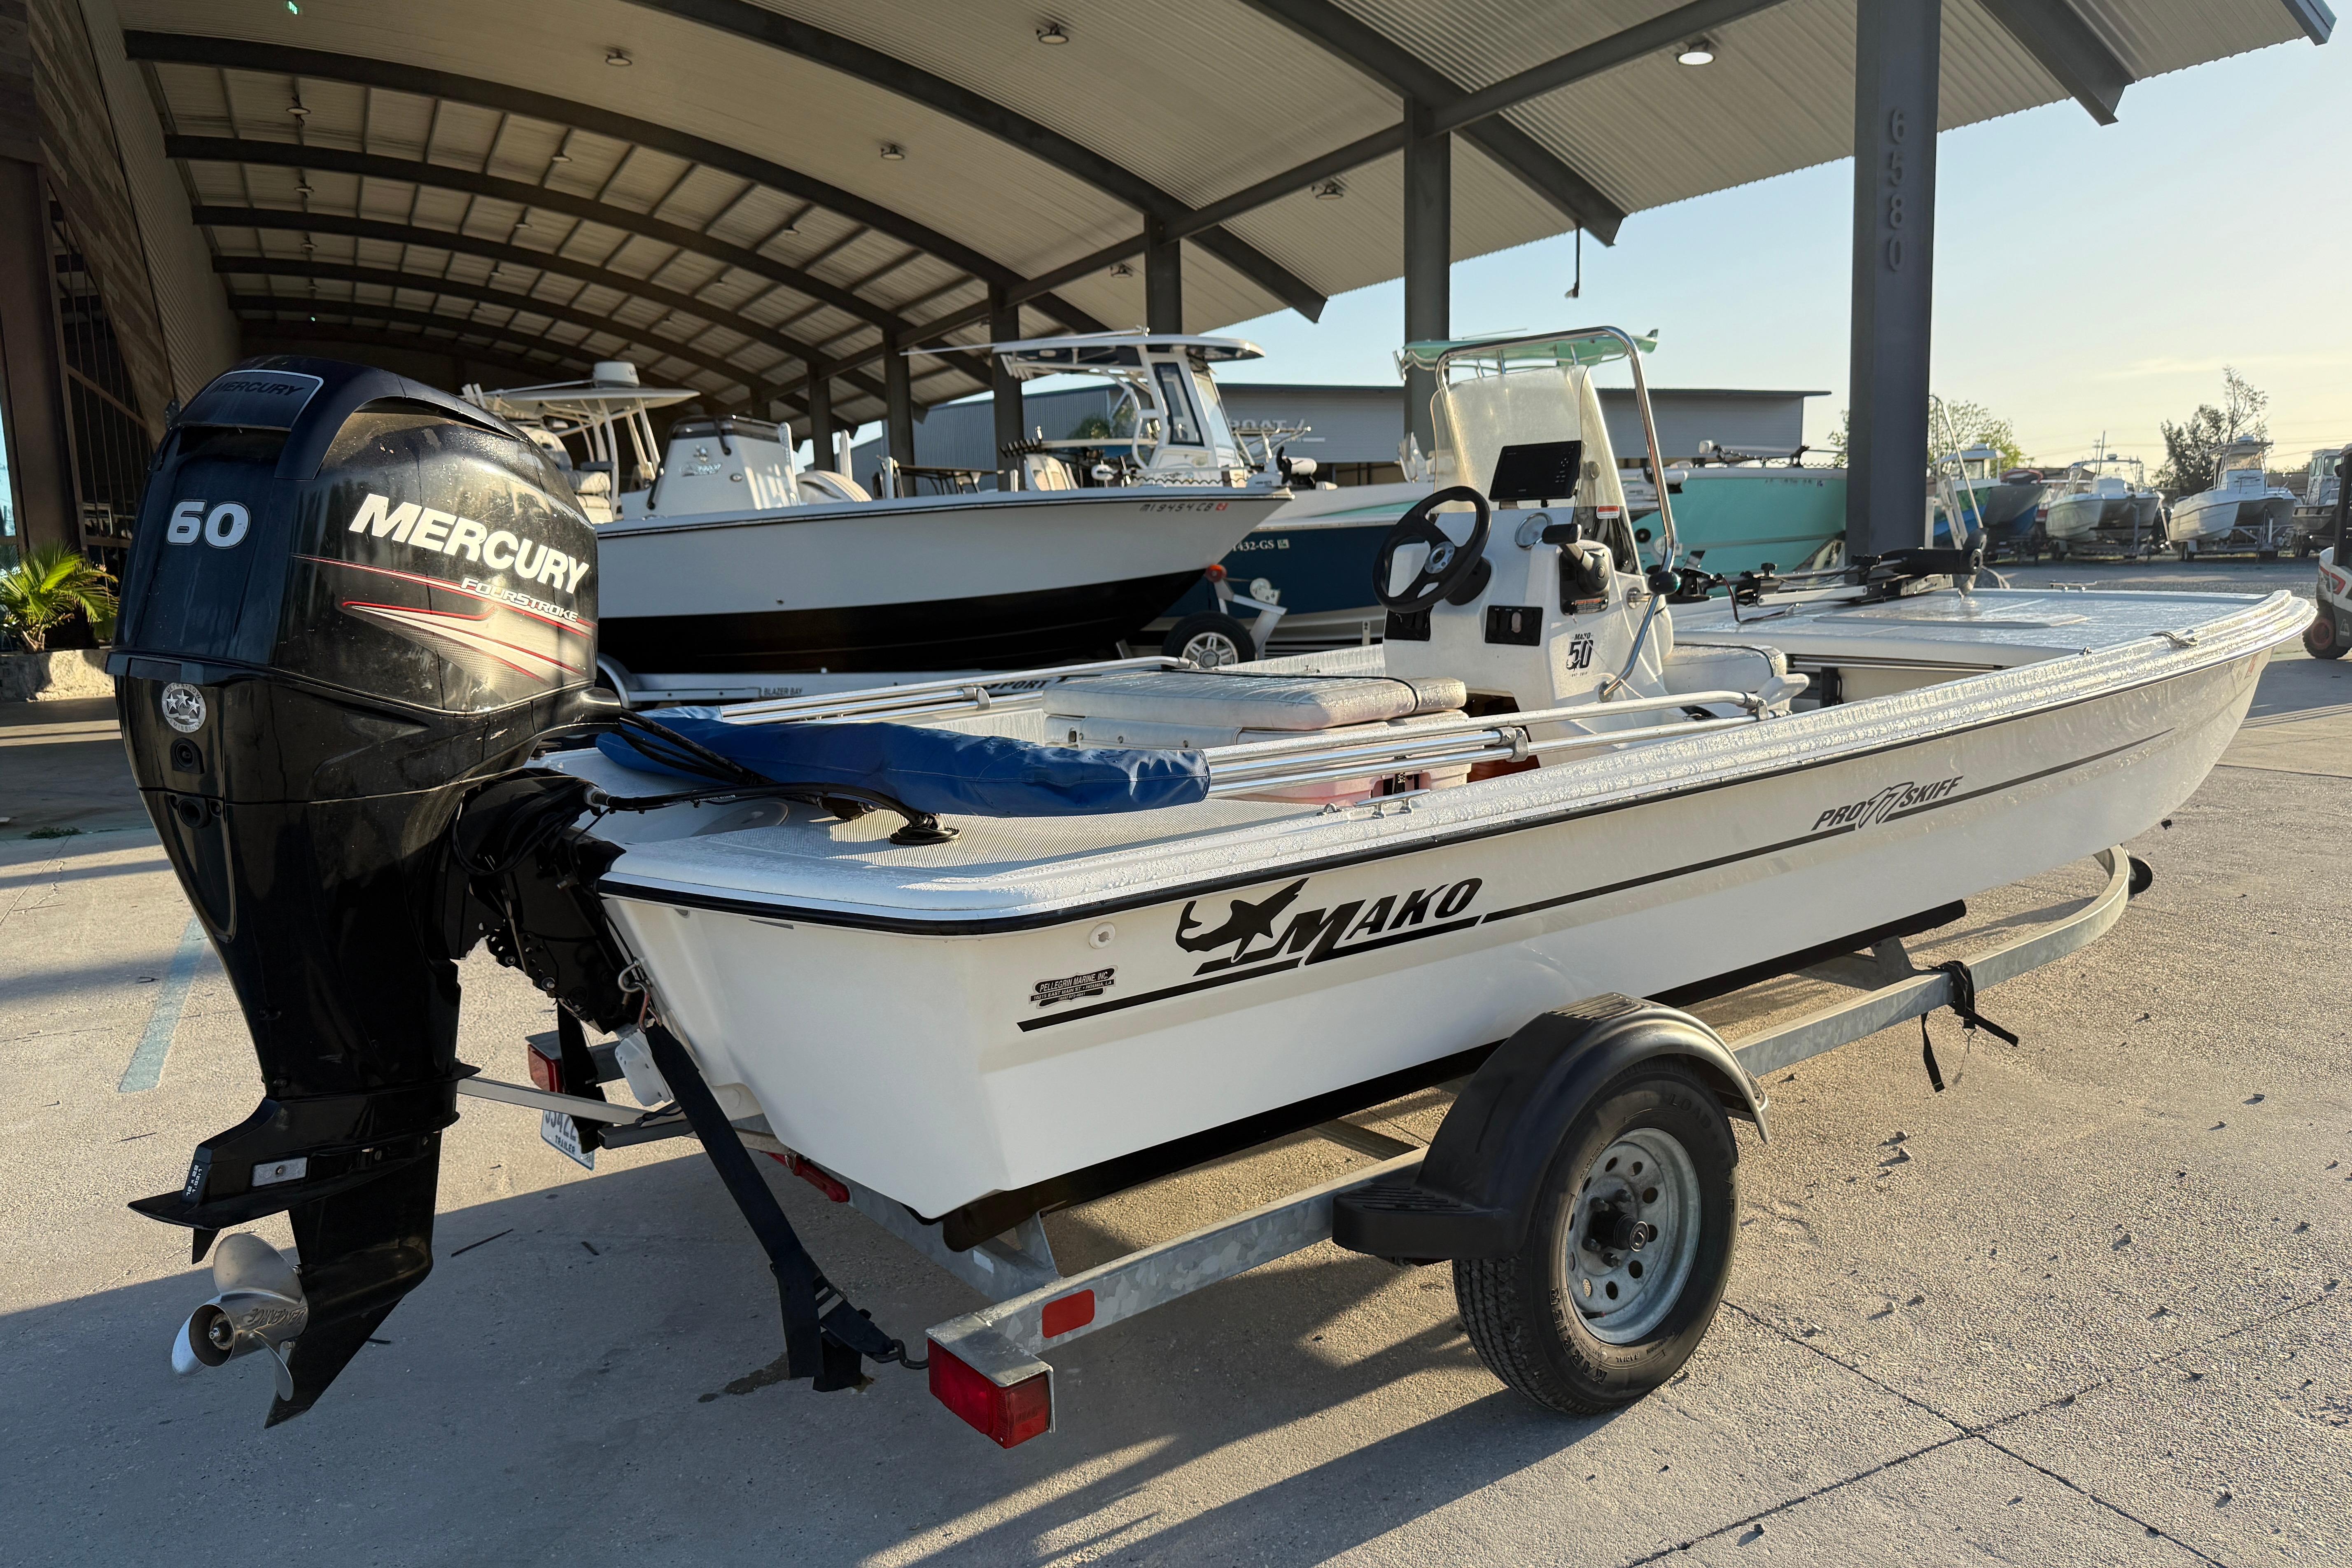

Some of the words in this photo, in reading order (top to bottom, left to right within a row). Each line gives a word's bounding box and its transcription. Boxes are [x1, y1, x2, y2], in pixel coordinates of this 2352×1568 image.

[1889, 108, 1906, 271] 6580
[209, 381, 306, 396] MERCURY
[166, 499, 251, 549] 60
[349, 493, 589, 594] MERCURY
[461, 577, 579, 622] FOURSTROKE
[1568, 640, 1594, 669] 50
[166, 683, 184, 693] ULTRA
[189, 686, 201, 699] LOW
[1811, 801, 1867, 831] PRO
[1899, 775, 1964, 808] SKIFF
[1270, 878, 1482, 966] MAKO
[1040, 978, 1072, 992] PELLEGRIN
[1098, 971, 1108, 980] INC.
[555, 1135, 576, 1155] TRAILER
[1549, 1288, 1608, 1384] KARRIER
[1616, 1353, 1640, 1363] RADIAL
